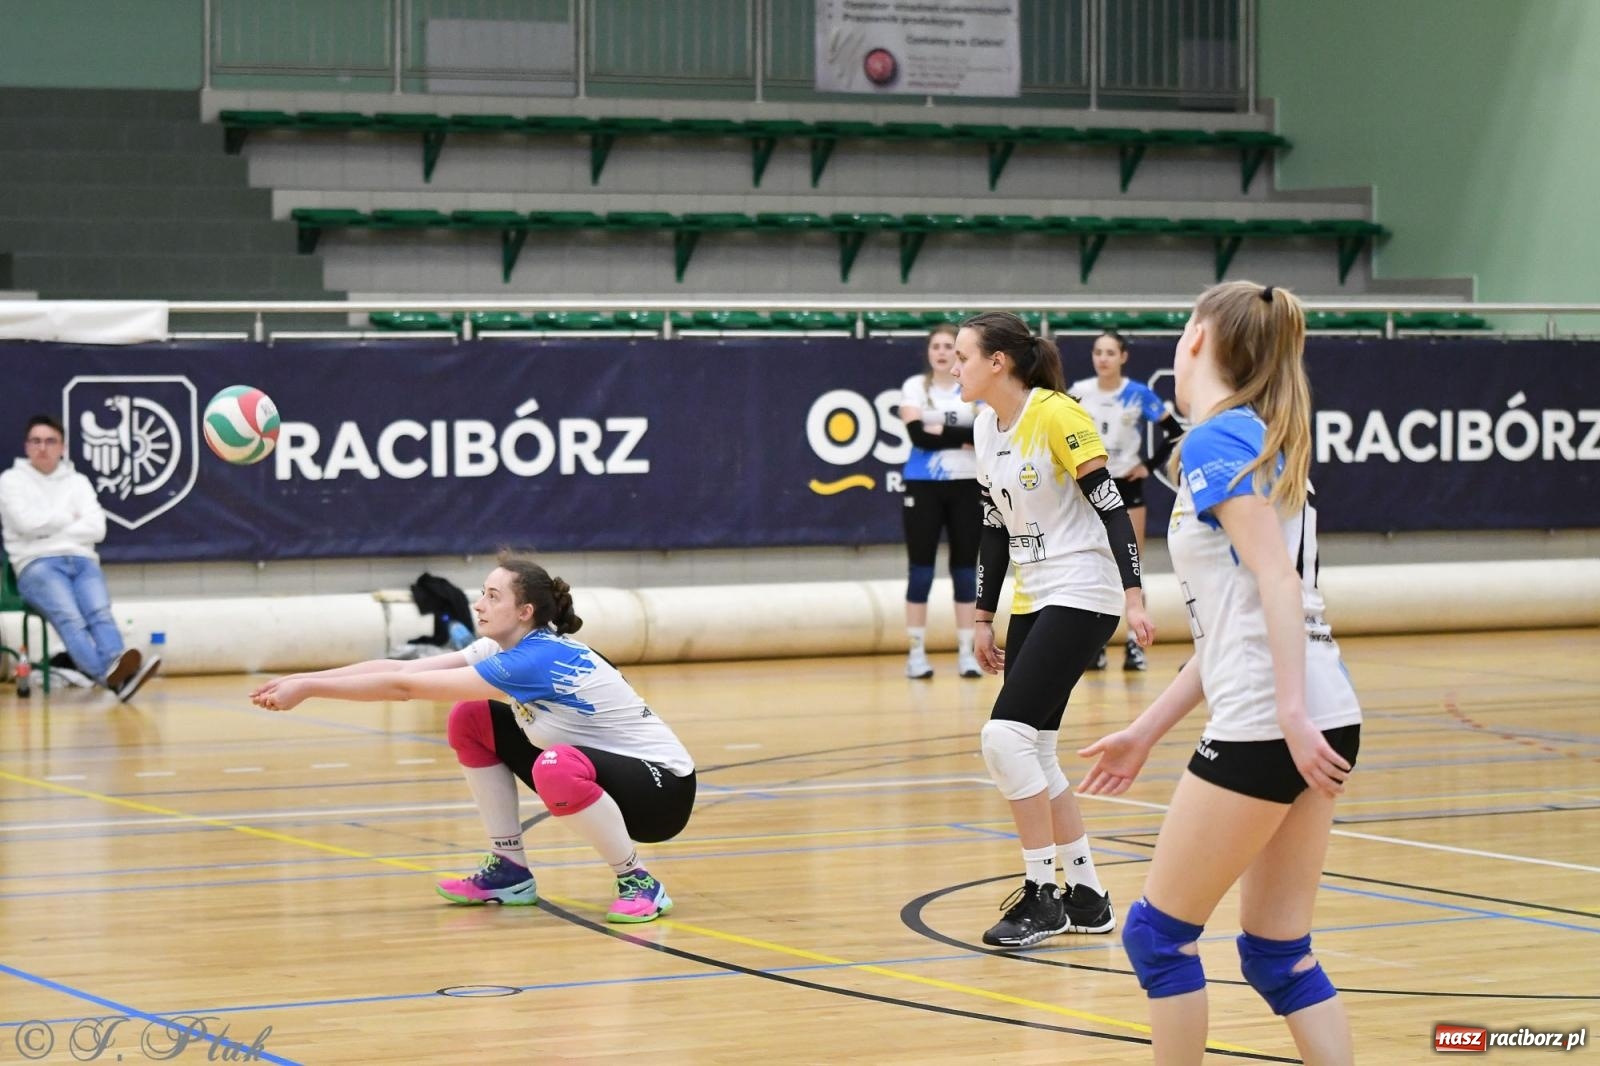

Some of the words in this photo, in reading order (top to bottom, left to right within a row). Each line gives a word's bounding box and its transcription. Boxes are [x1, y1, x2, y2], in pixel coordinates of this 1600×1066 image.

[944, 411, 957, 425] 16
[275, 398, 650, 480] RACIBÓRZ
[1127, 543, 1140, 576] ORACZ
